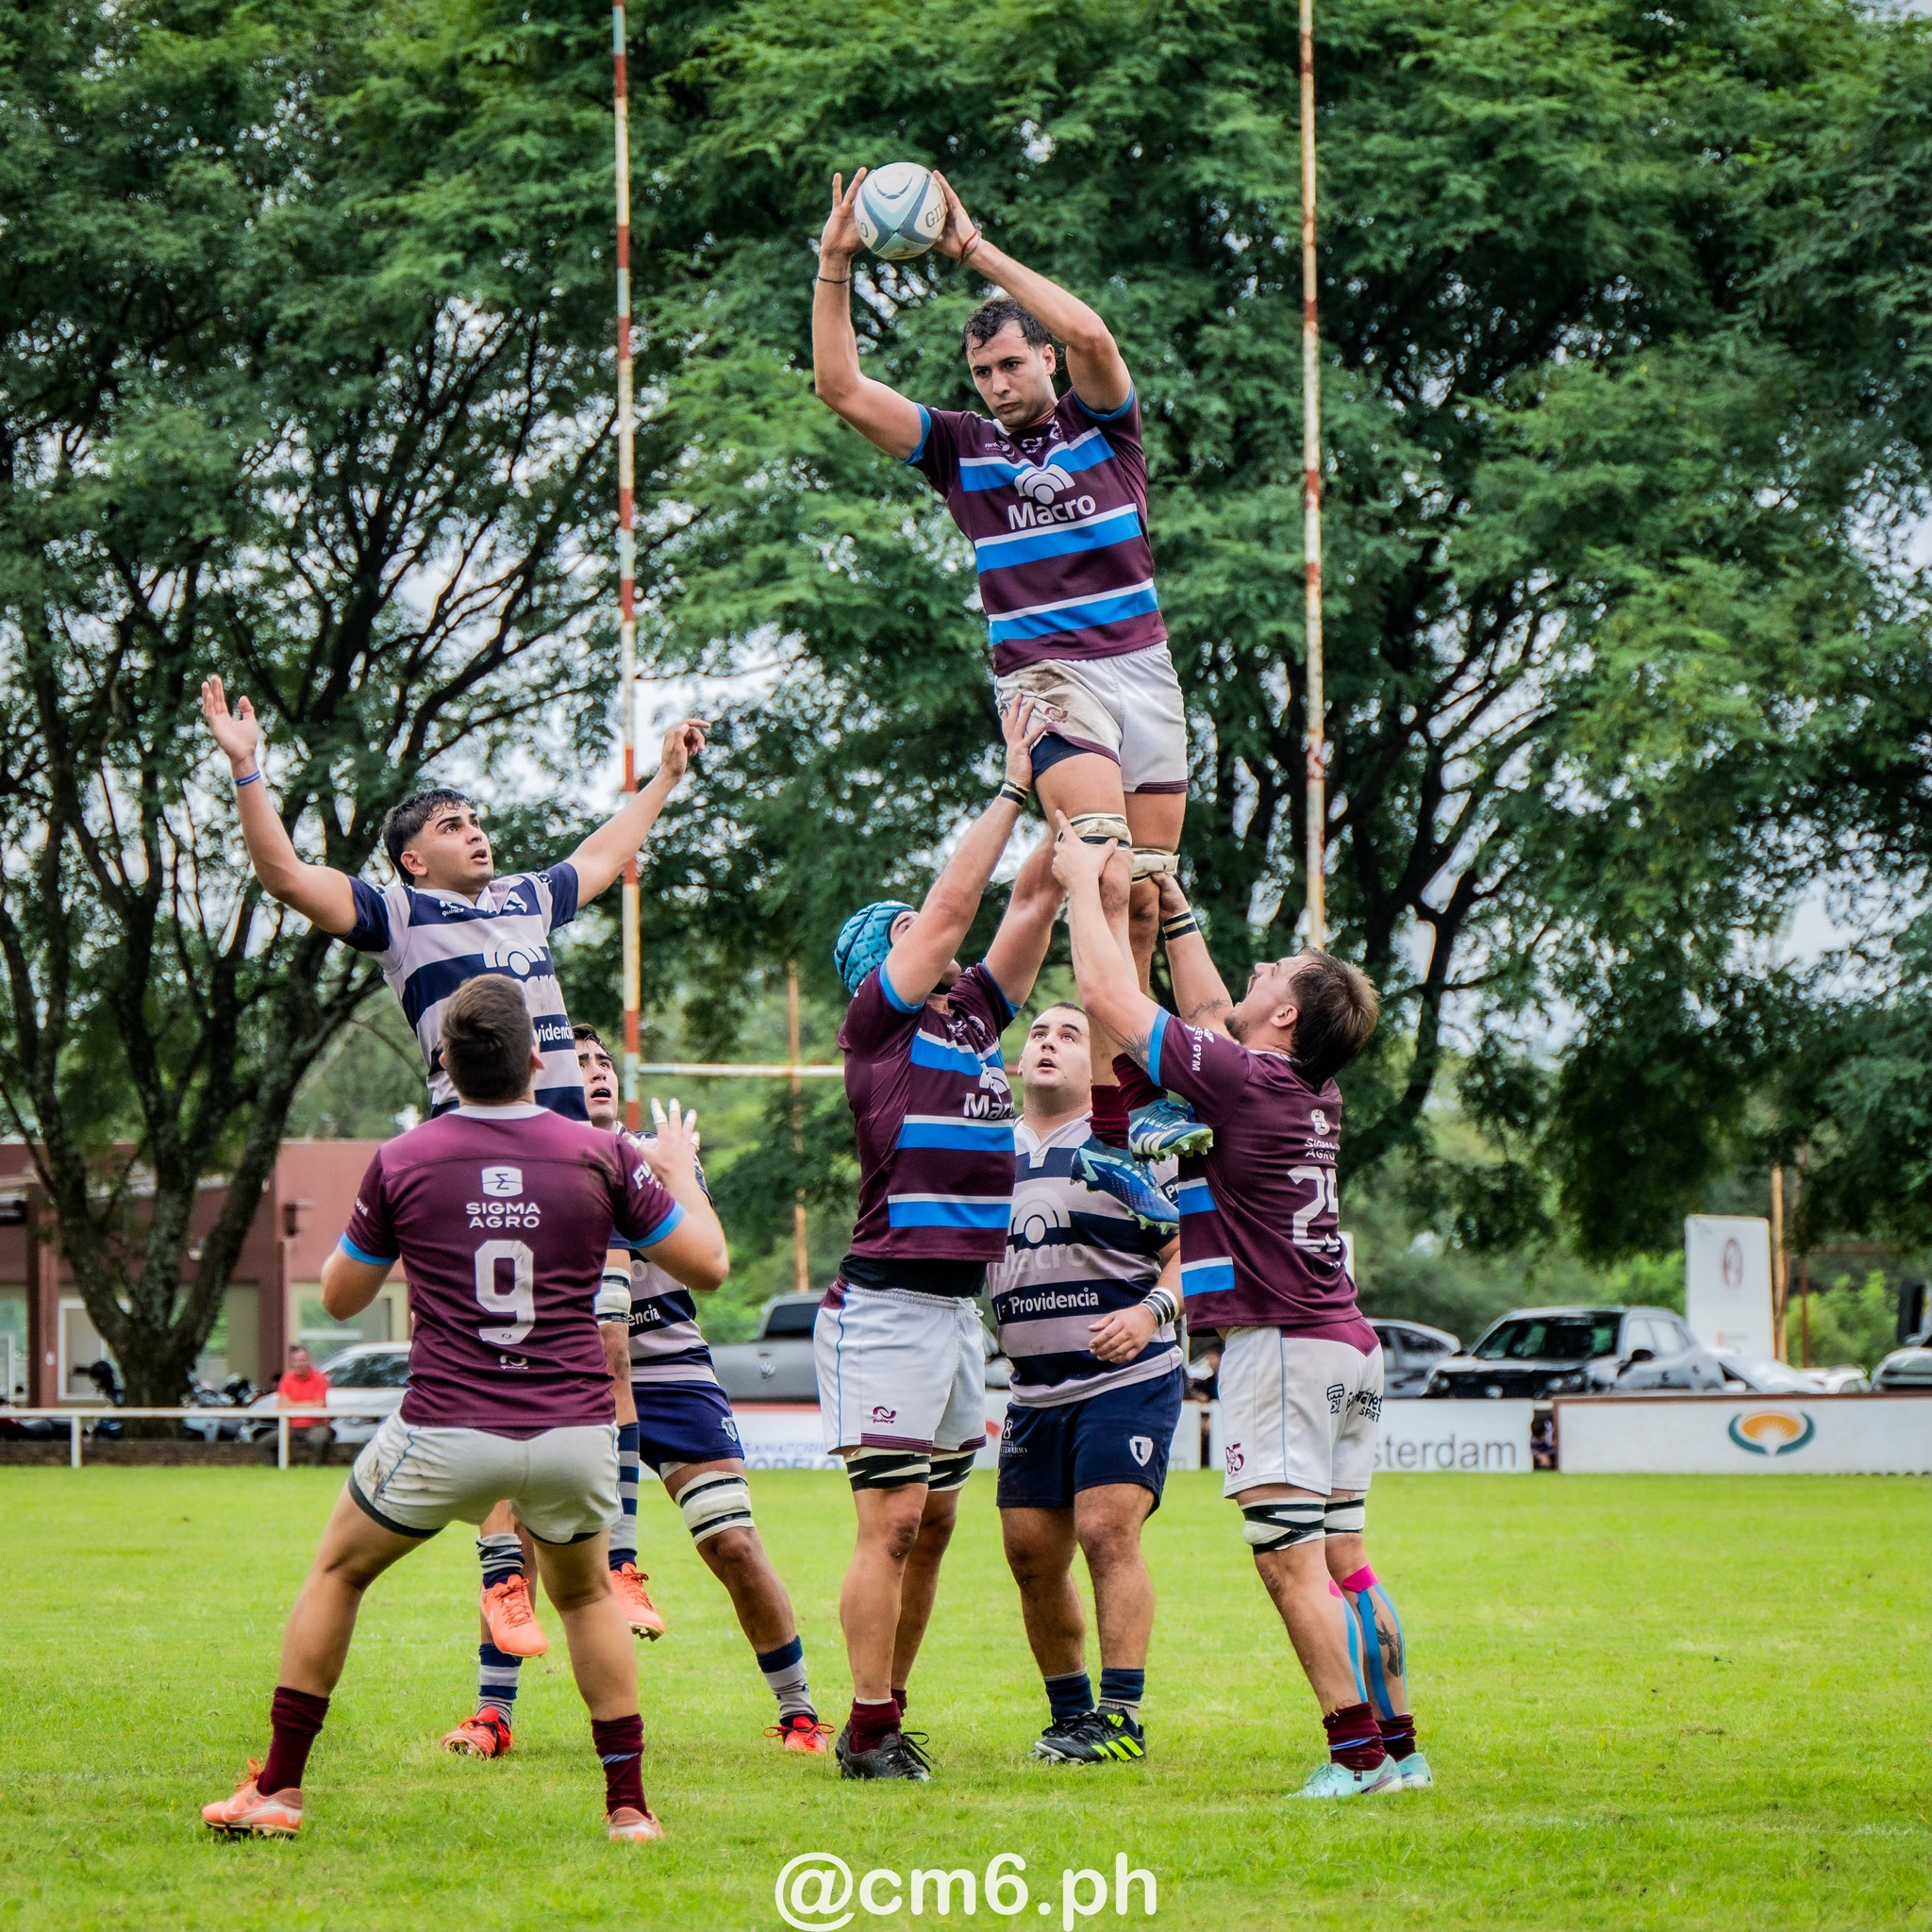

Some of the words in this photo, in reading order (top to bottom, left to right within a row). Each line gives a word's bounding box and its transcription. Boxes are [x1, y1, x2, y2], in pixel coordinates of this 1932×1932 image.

[1008, 495, 1096, 530] Macro
[534, 1021, 574, 1043] videncia
[1191, 1043, 1202, 1072] GYM
[466, 1202, 541, 1215] SIGMA
[469, 1216, 541, 1228] AGRO
[475, 1241, 534, 1344] 9
[1008, 1287, 1099, 1315] Providencia
[1374, 1432, 1516, 1469] sterdam
